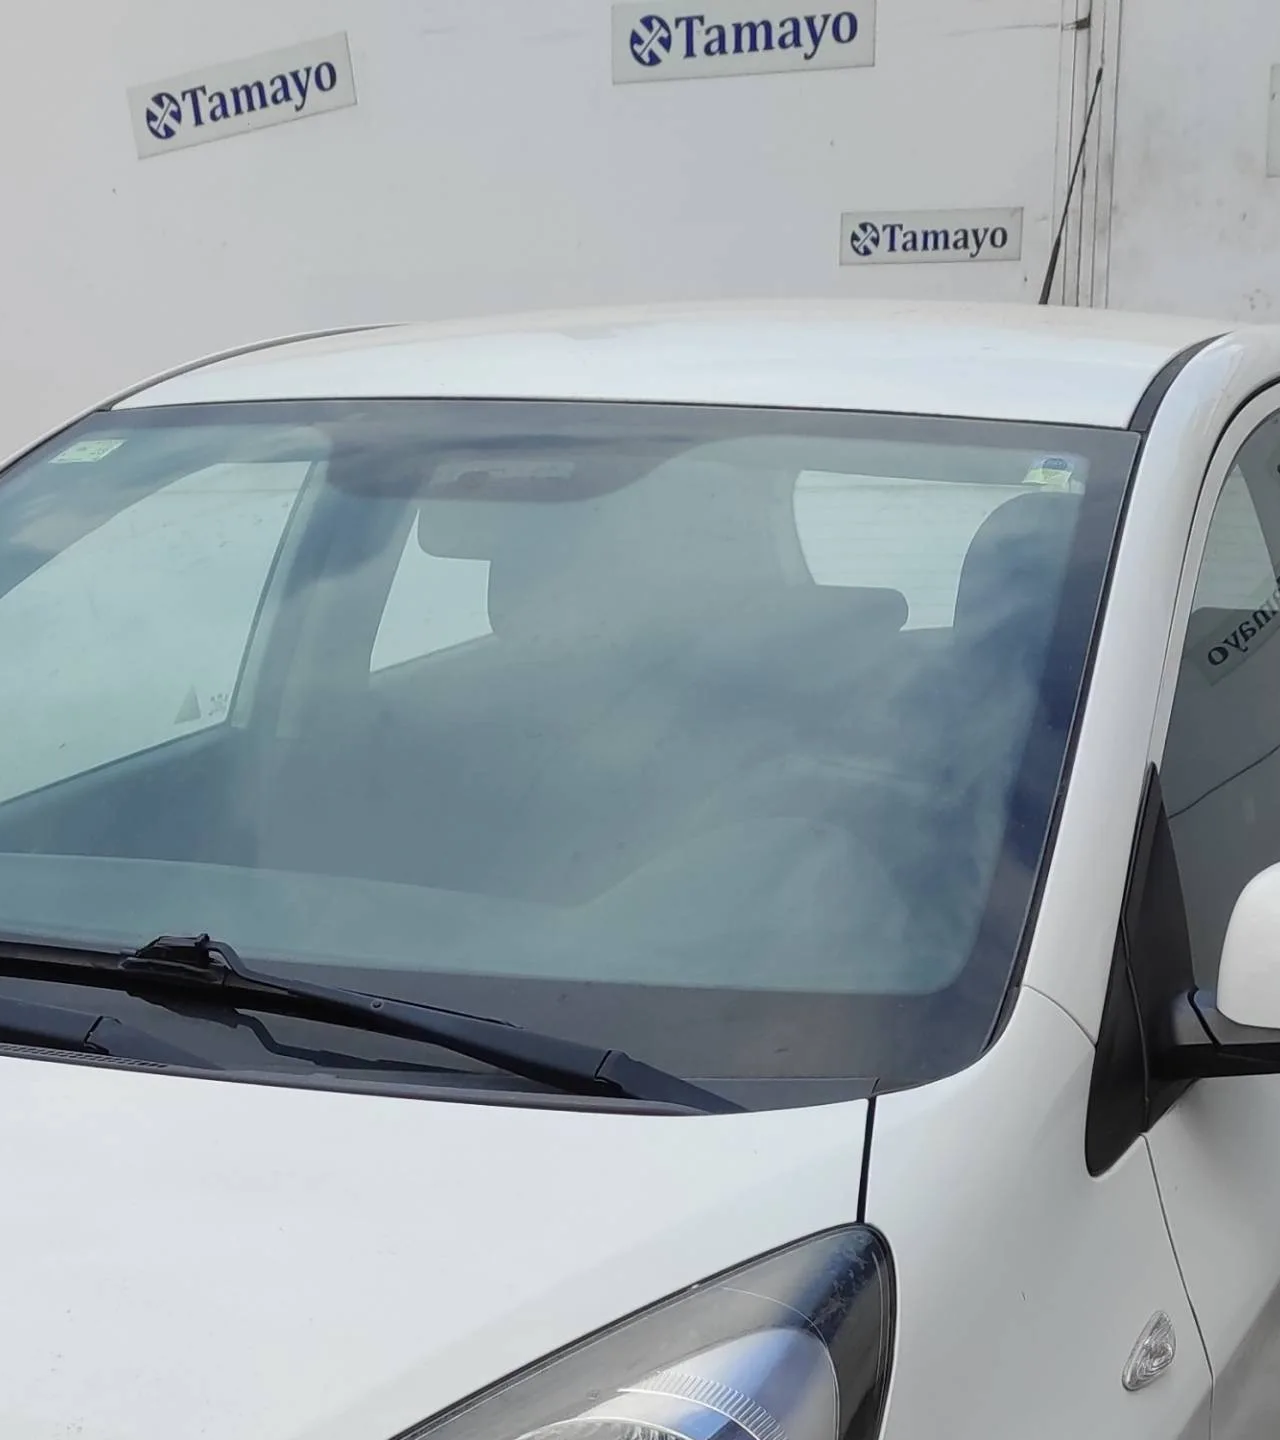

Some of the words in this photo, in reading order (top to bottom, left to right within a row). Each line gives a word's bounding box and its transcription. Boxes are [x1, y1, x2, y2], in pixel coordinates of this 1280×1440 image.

[677, 11, 858, 60] Tamayo
[182, 61, 337, 128] Tamayo
[882, 223, 1008, 258] Tamayo
